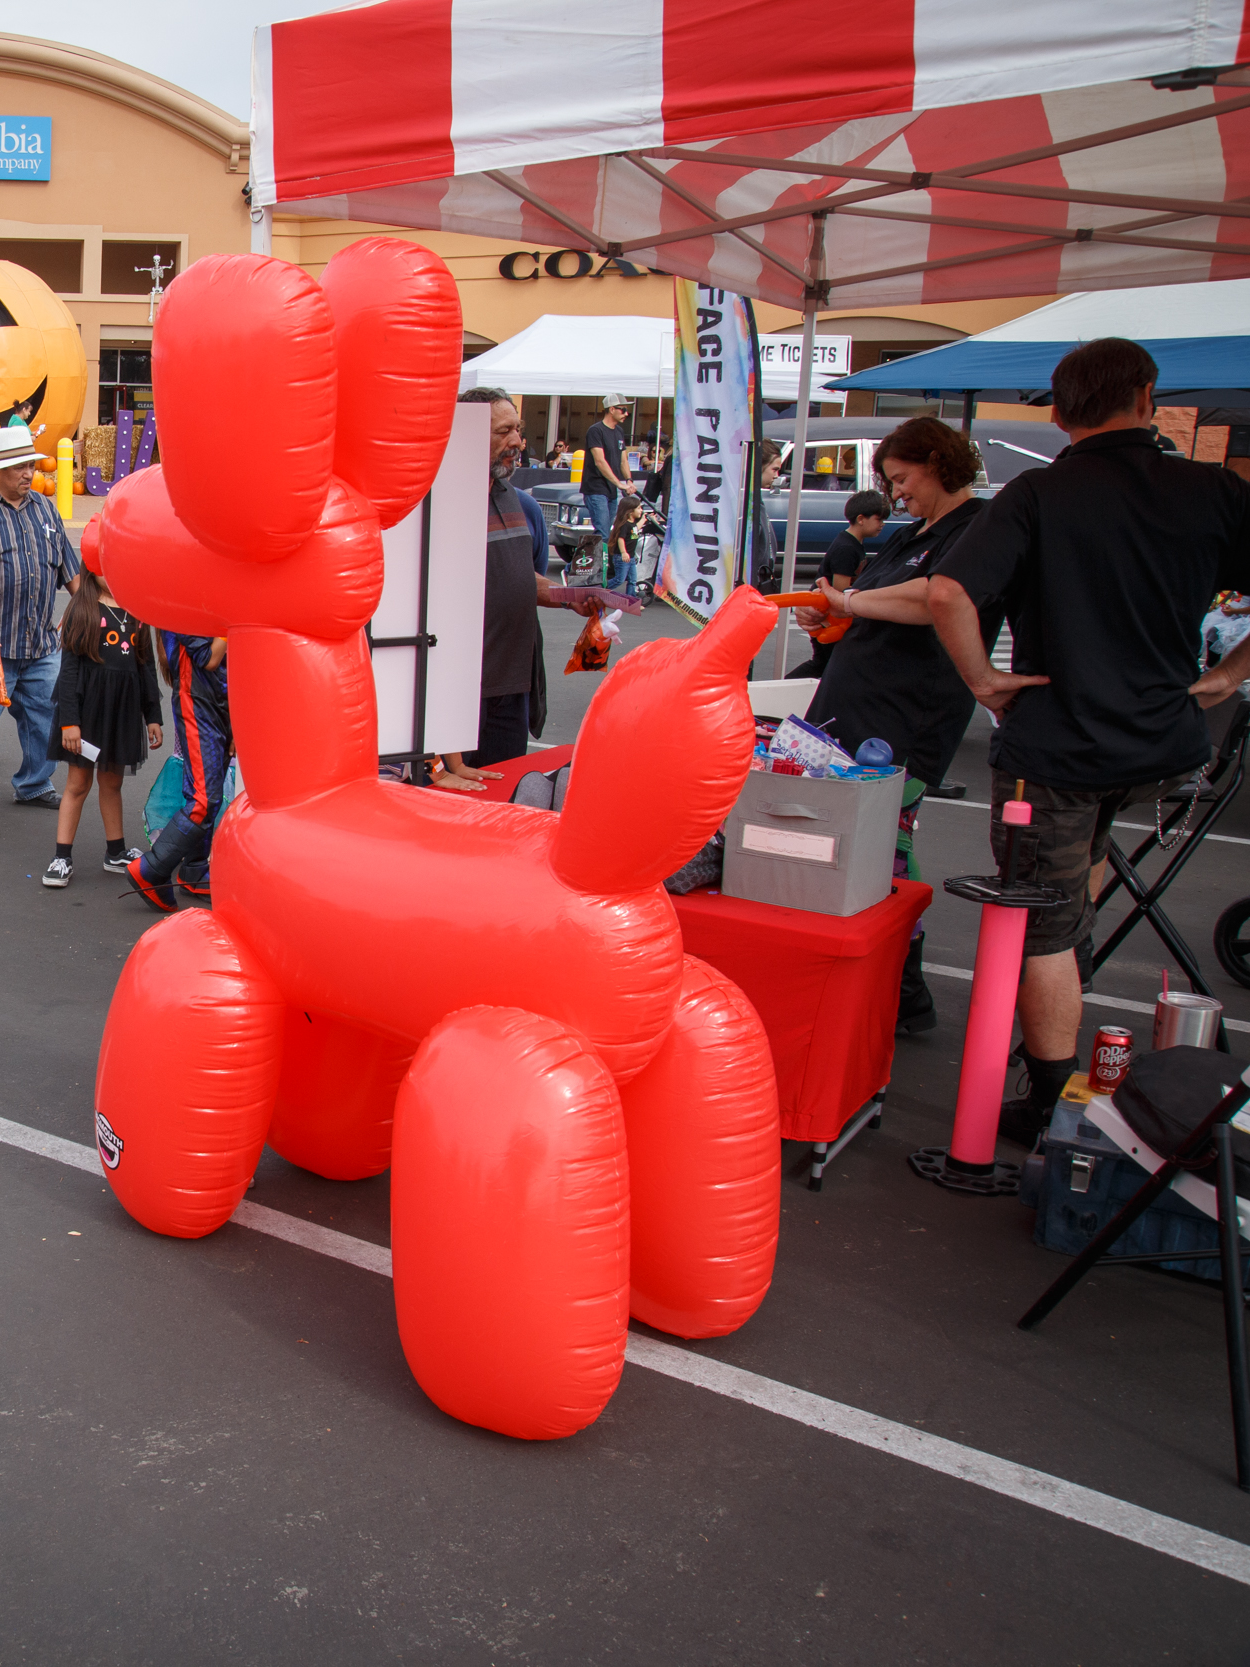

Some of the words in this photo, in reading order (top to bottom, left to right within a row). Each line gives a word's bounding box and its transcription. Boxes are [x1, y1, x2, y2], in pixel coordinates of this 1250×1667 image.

[499, 249, 674, 280] COA
[696, 282, 724, 383] FACE
[780, 343, 837, 363] TICETS
[687, 408, 723, 605] PAINTING
[1096, 1047, 1132, 1066] Pepper
[1110, 1046, 1126, 1057] Dr
